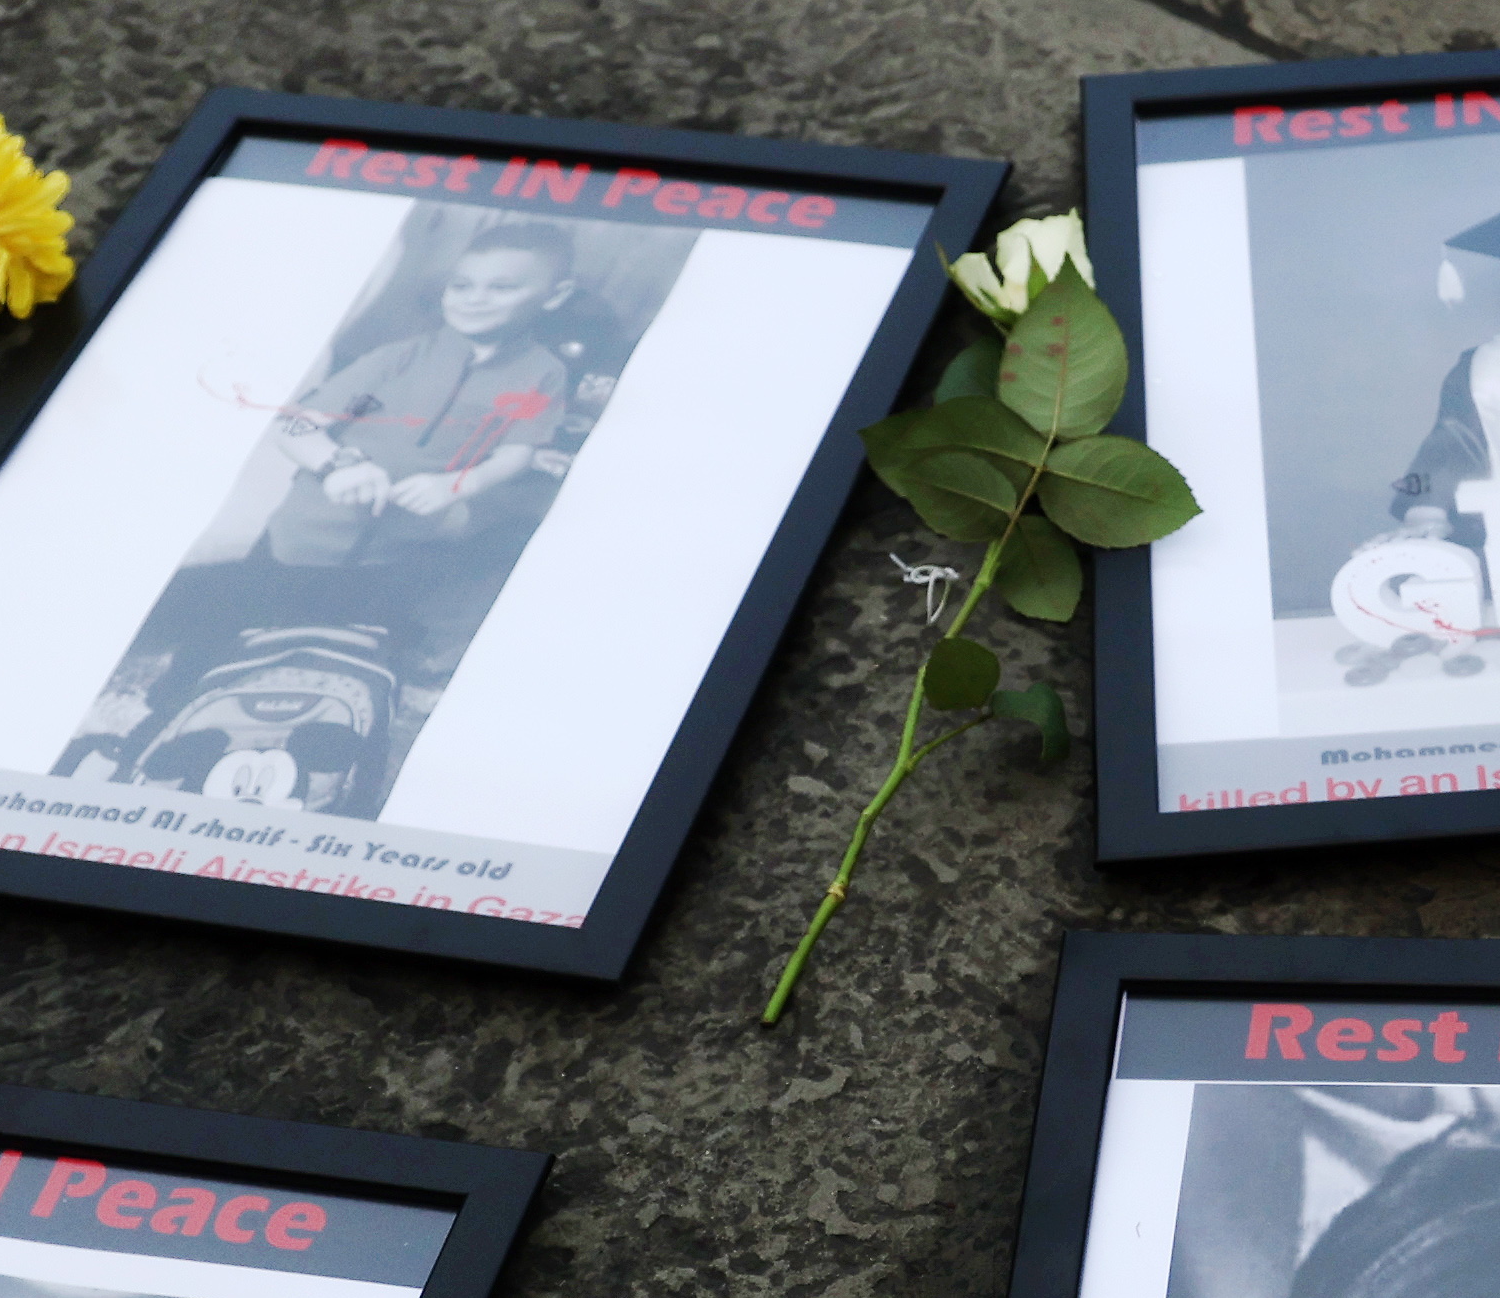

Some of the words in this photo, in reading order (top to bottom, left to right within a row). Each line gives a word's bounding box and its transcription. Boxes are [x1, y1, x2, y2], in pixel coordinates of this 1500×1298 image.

[1234, 99, 1407, 143] Rest
[305, 137, 479, 190] Rest
[496, 155, 592, 201] IN
[603, 167, 836, 227] Peace
[1180, 782, 1308, 811] killed
[1327, 779, 1381, 801] by
[1401, 774, 1458, 795] an
[39, 832, 183, 873] Israeli
[194, 855, 397, 900] Airstrike
[410, 887, 453, 910] in
[151, 810, 187, 831] Al
[190, 819, 285, 846] sharif
[306, 835, 352, 857] Six
[364, 842, 449, 871] Years
[457, 860, 513, 880] old
[1246, 1004, 1468, 1062] Rest
[33, 1156, 326, 1249] Peace
